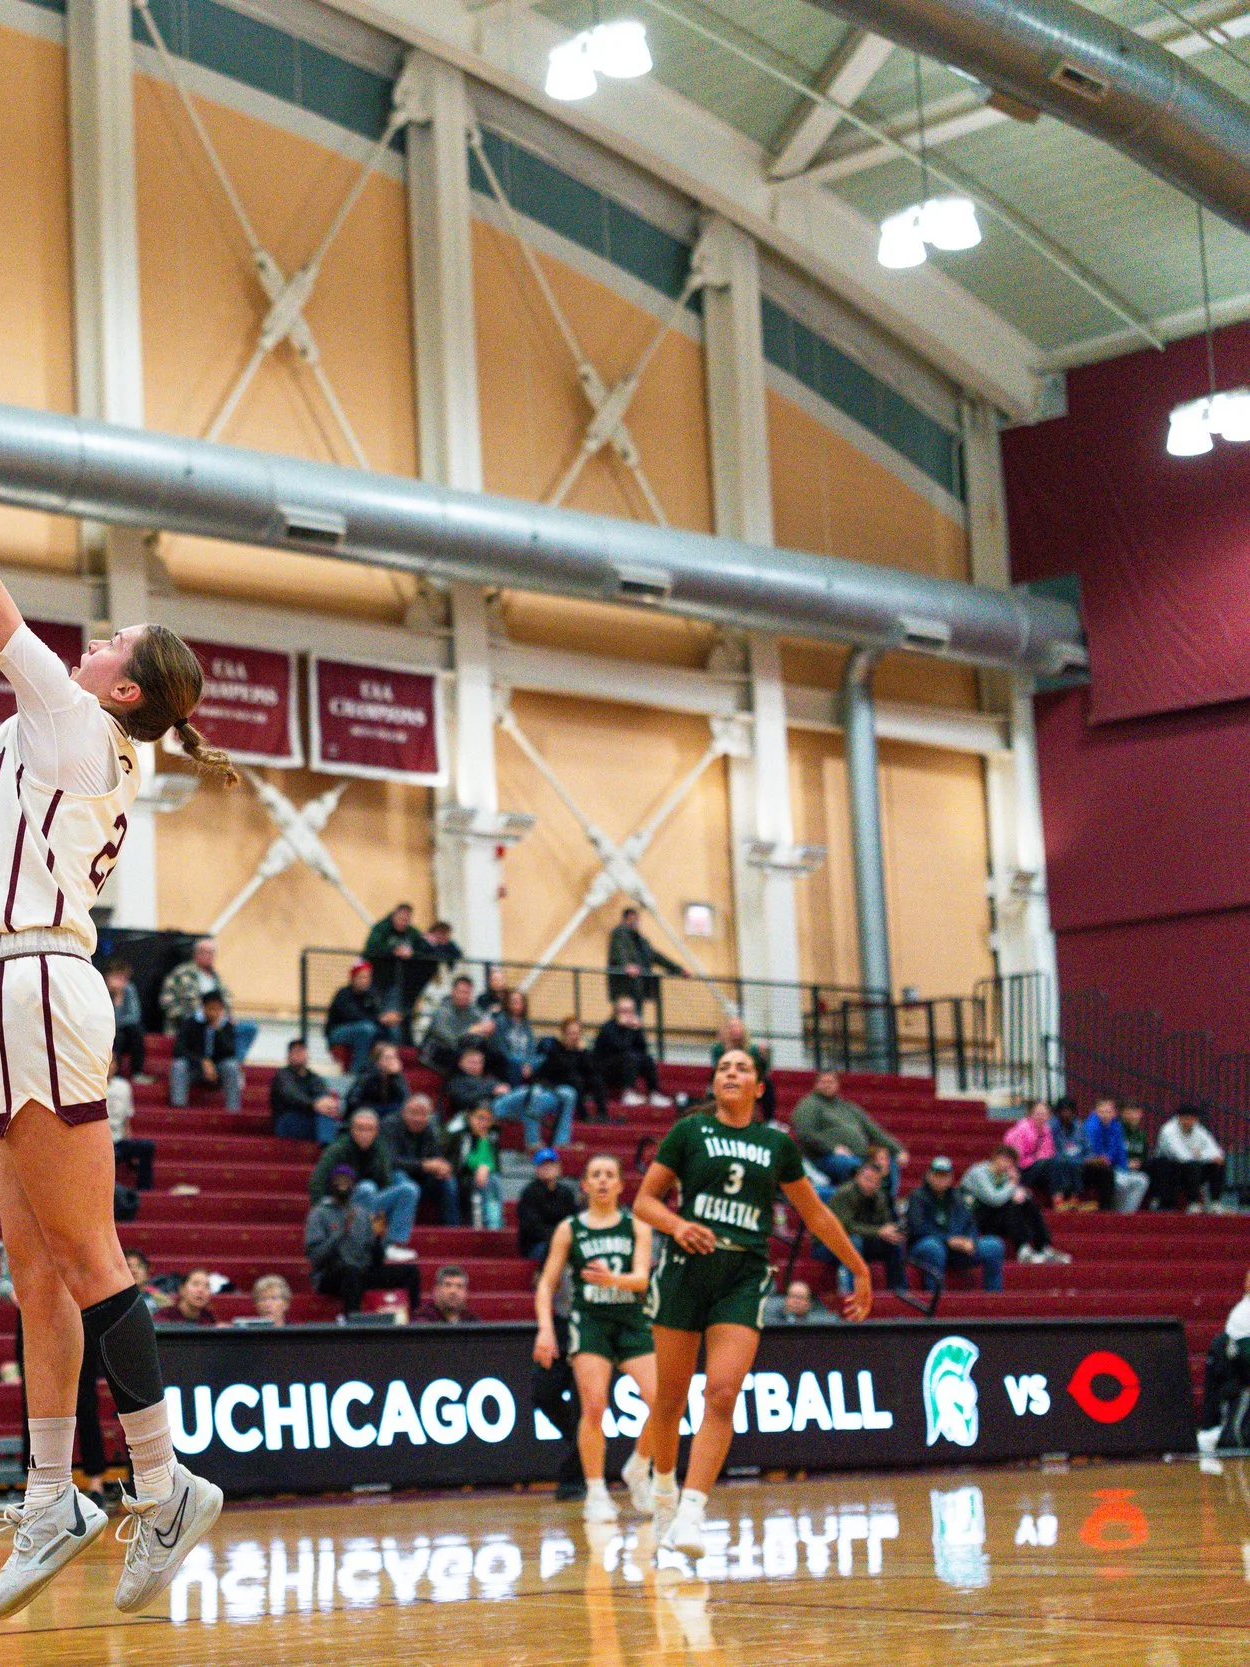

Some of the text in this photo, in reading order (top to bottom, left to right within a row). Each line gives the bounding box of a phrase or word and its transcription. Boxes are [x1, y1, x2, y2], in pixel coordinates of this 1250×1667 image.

[704, 1136, 771, 1169] ILLINOIS
[723, 1162, 746, 1196] 3
[164, 1377, 516, 1454] UCHICAGO
